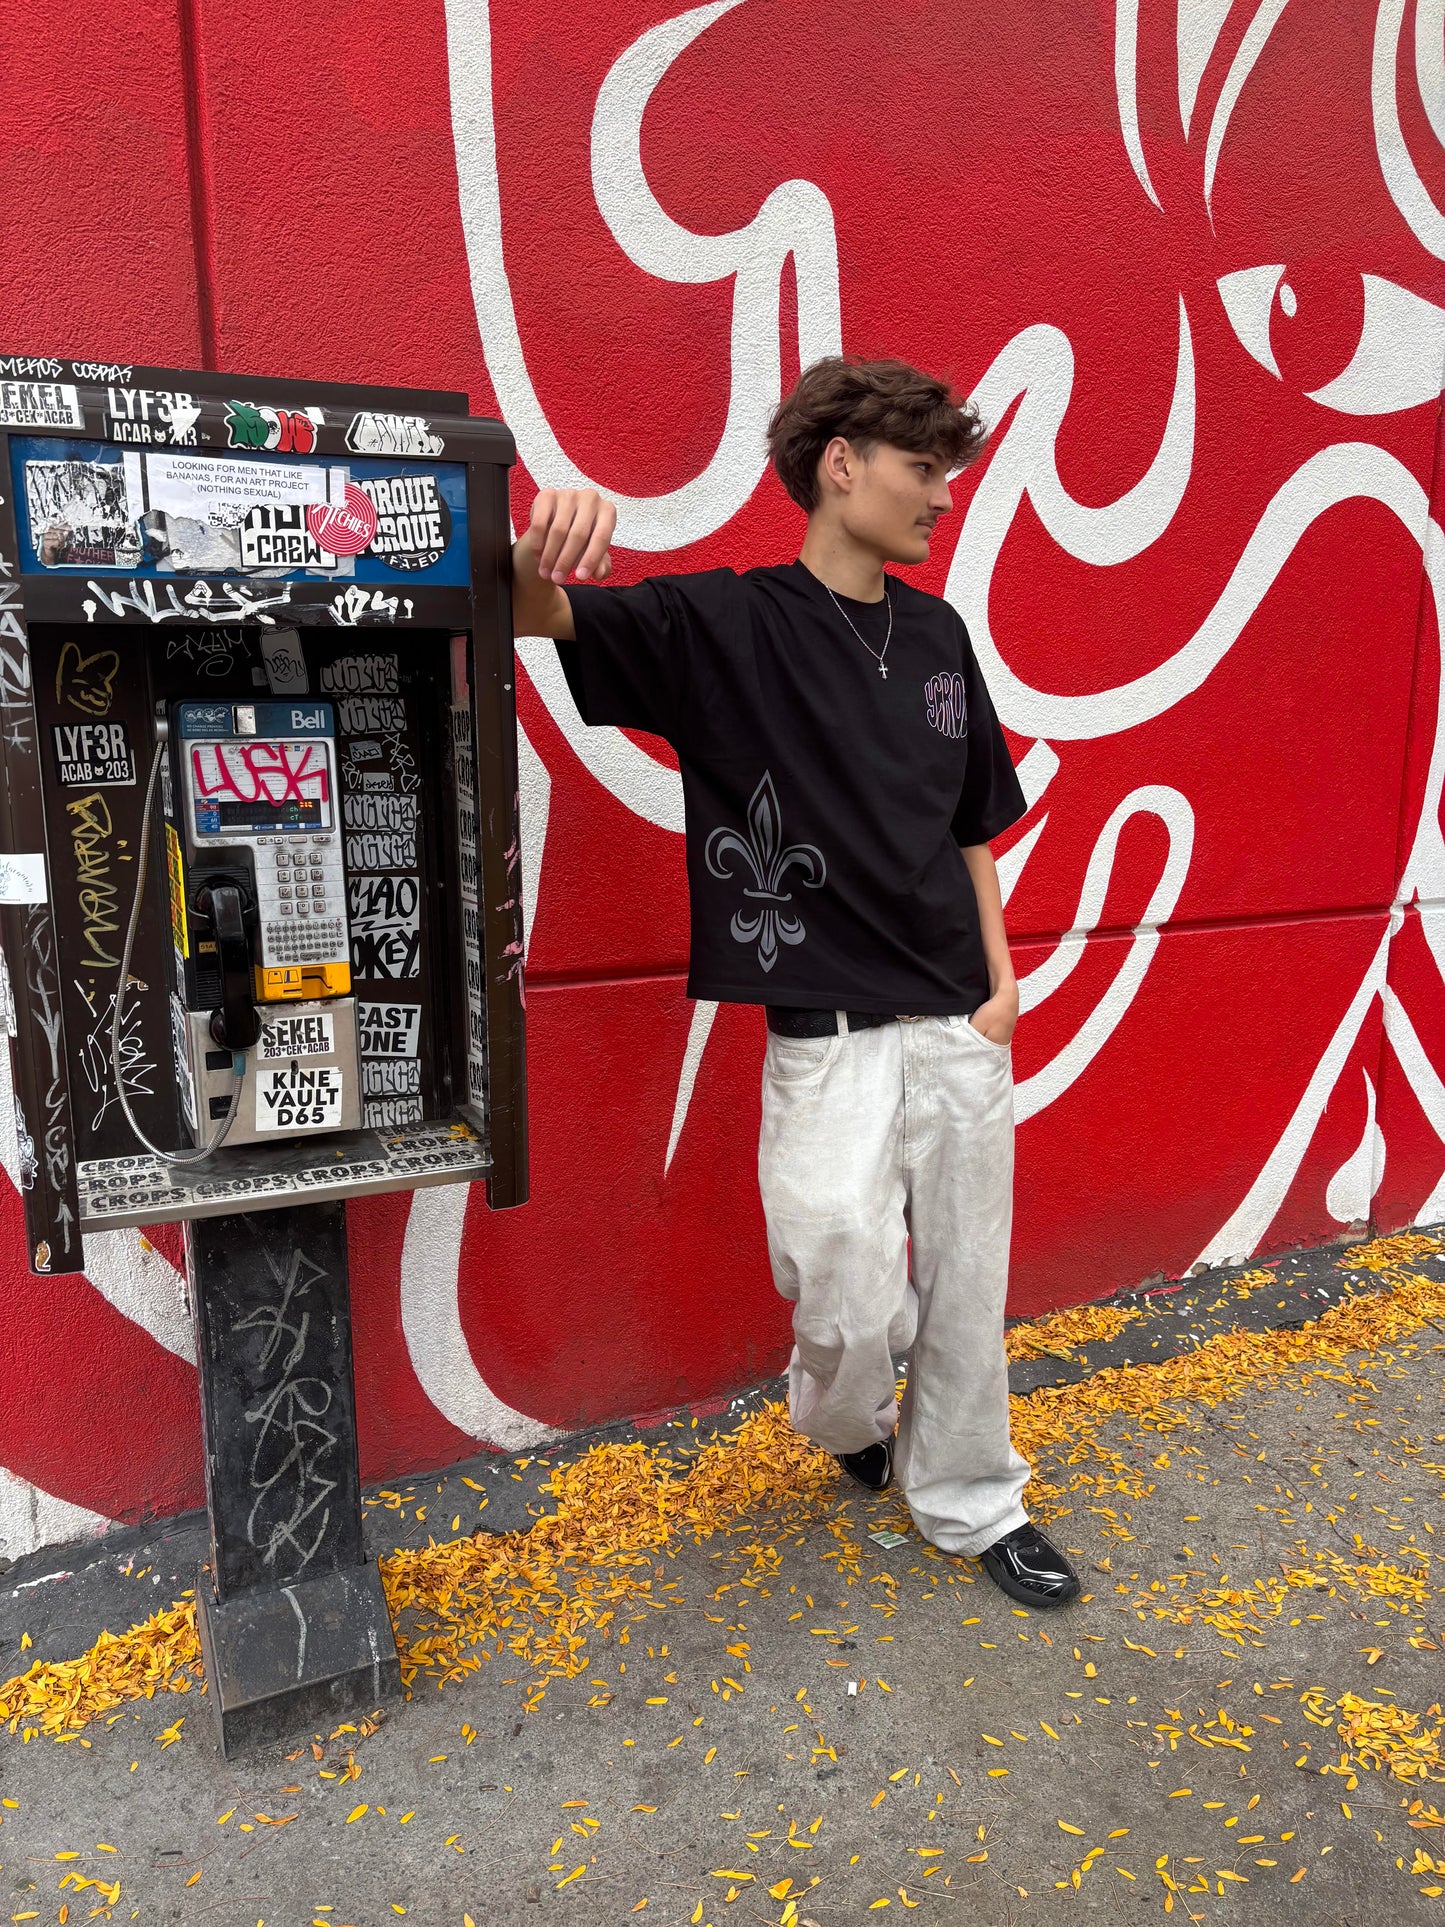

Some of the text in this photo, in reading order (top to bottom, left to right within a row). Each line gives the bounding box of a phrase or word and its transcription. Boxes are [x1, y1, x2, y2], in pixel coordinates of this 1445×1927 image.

[0, 383, 72, 410] EKEL
[166, 471, 310, 491] BANANAS, FOR AN ART PROJECT
[172, 461, 303, 480] LOOKING FOR MEN THAT LIKE
[197, 484, 282, 499] (NOTHING SEXUAL)
[354, 476, 439, 514] ORQUE
[291, 709, 326, 729] Bell
[453, 710, 470, 743] CROP
[54, 724, 127, 762] LYF3R
[61, 760, 130, 782] ACAB 203
[261, 1017, 329, 1048] SEKEL
[273, 1070, 331, 1089] KINE
[263, 1088, 339, 1109] VAULT
[277, 1107, 325, 1126] D65
[390, 1150, 475, 1169] CROPS
[78, 1172, 164, 1191] CROPS
[296, 1161, 385, 1183] CROPS
[196, 1174, 288, 1196] CROPS
[91, 1187, 187, 1208] CROPS
